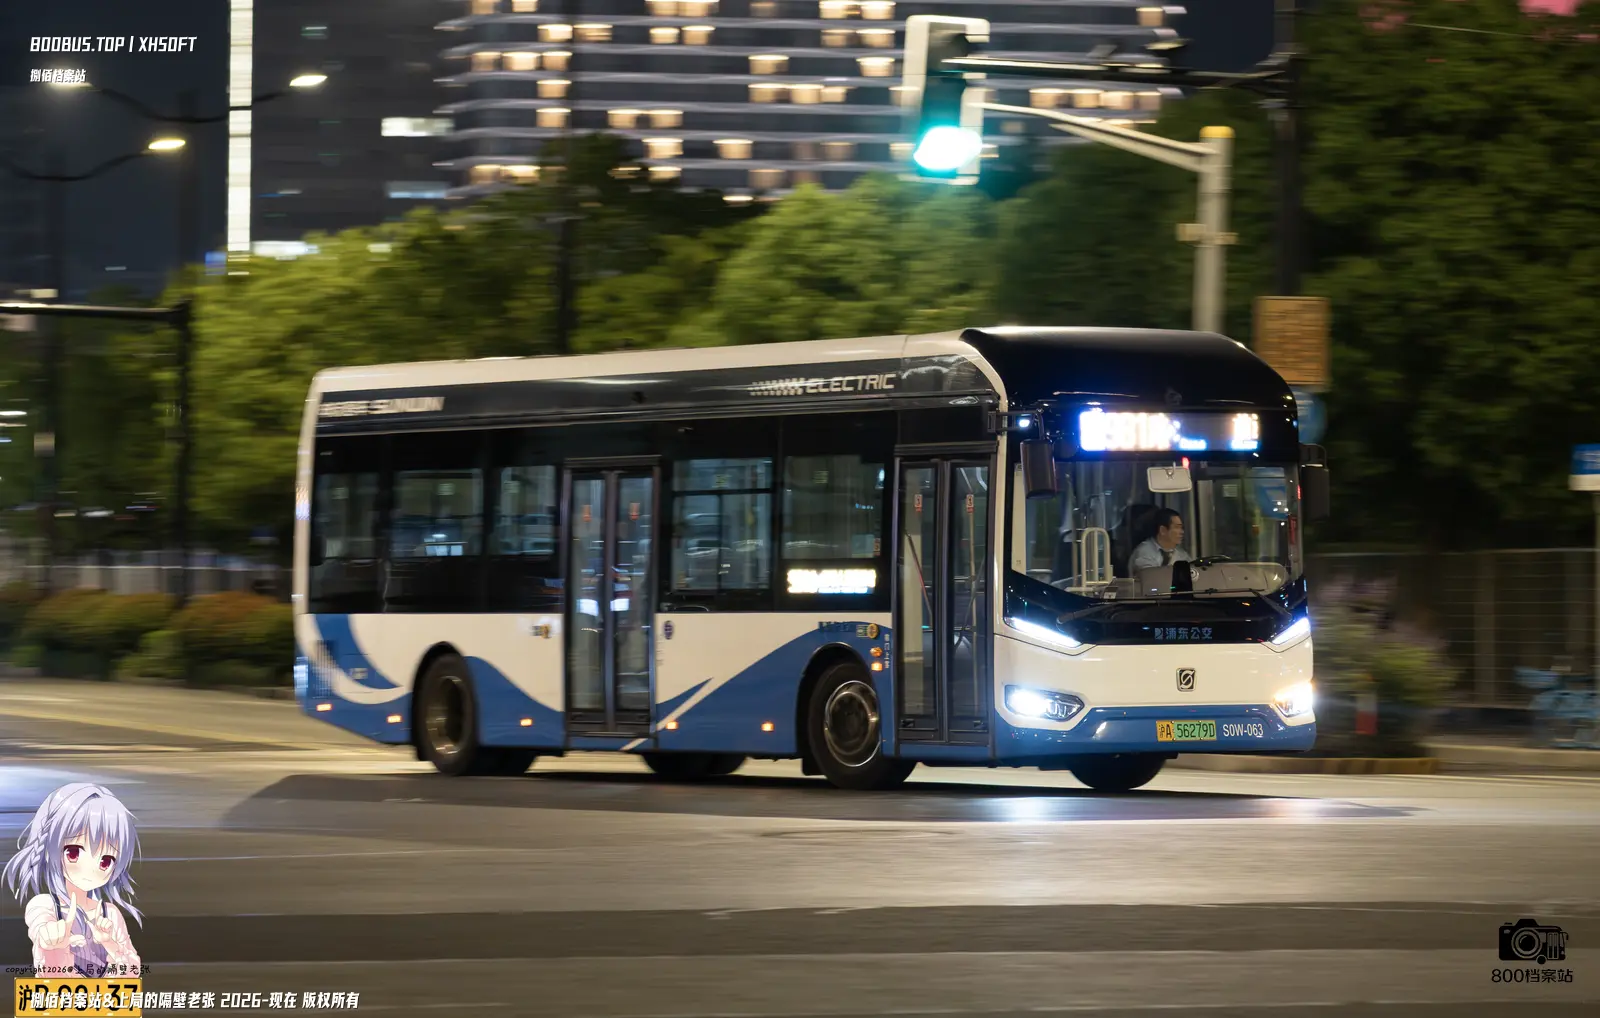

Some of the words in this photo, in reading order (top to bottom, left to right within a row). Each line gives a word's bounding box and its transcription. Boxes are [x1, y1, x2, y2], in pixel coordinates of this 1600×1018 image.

[806, 373, 897, 394] ELECTRIC
[1165, 627, 1213, 640] 浦东公交
